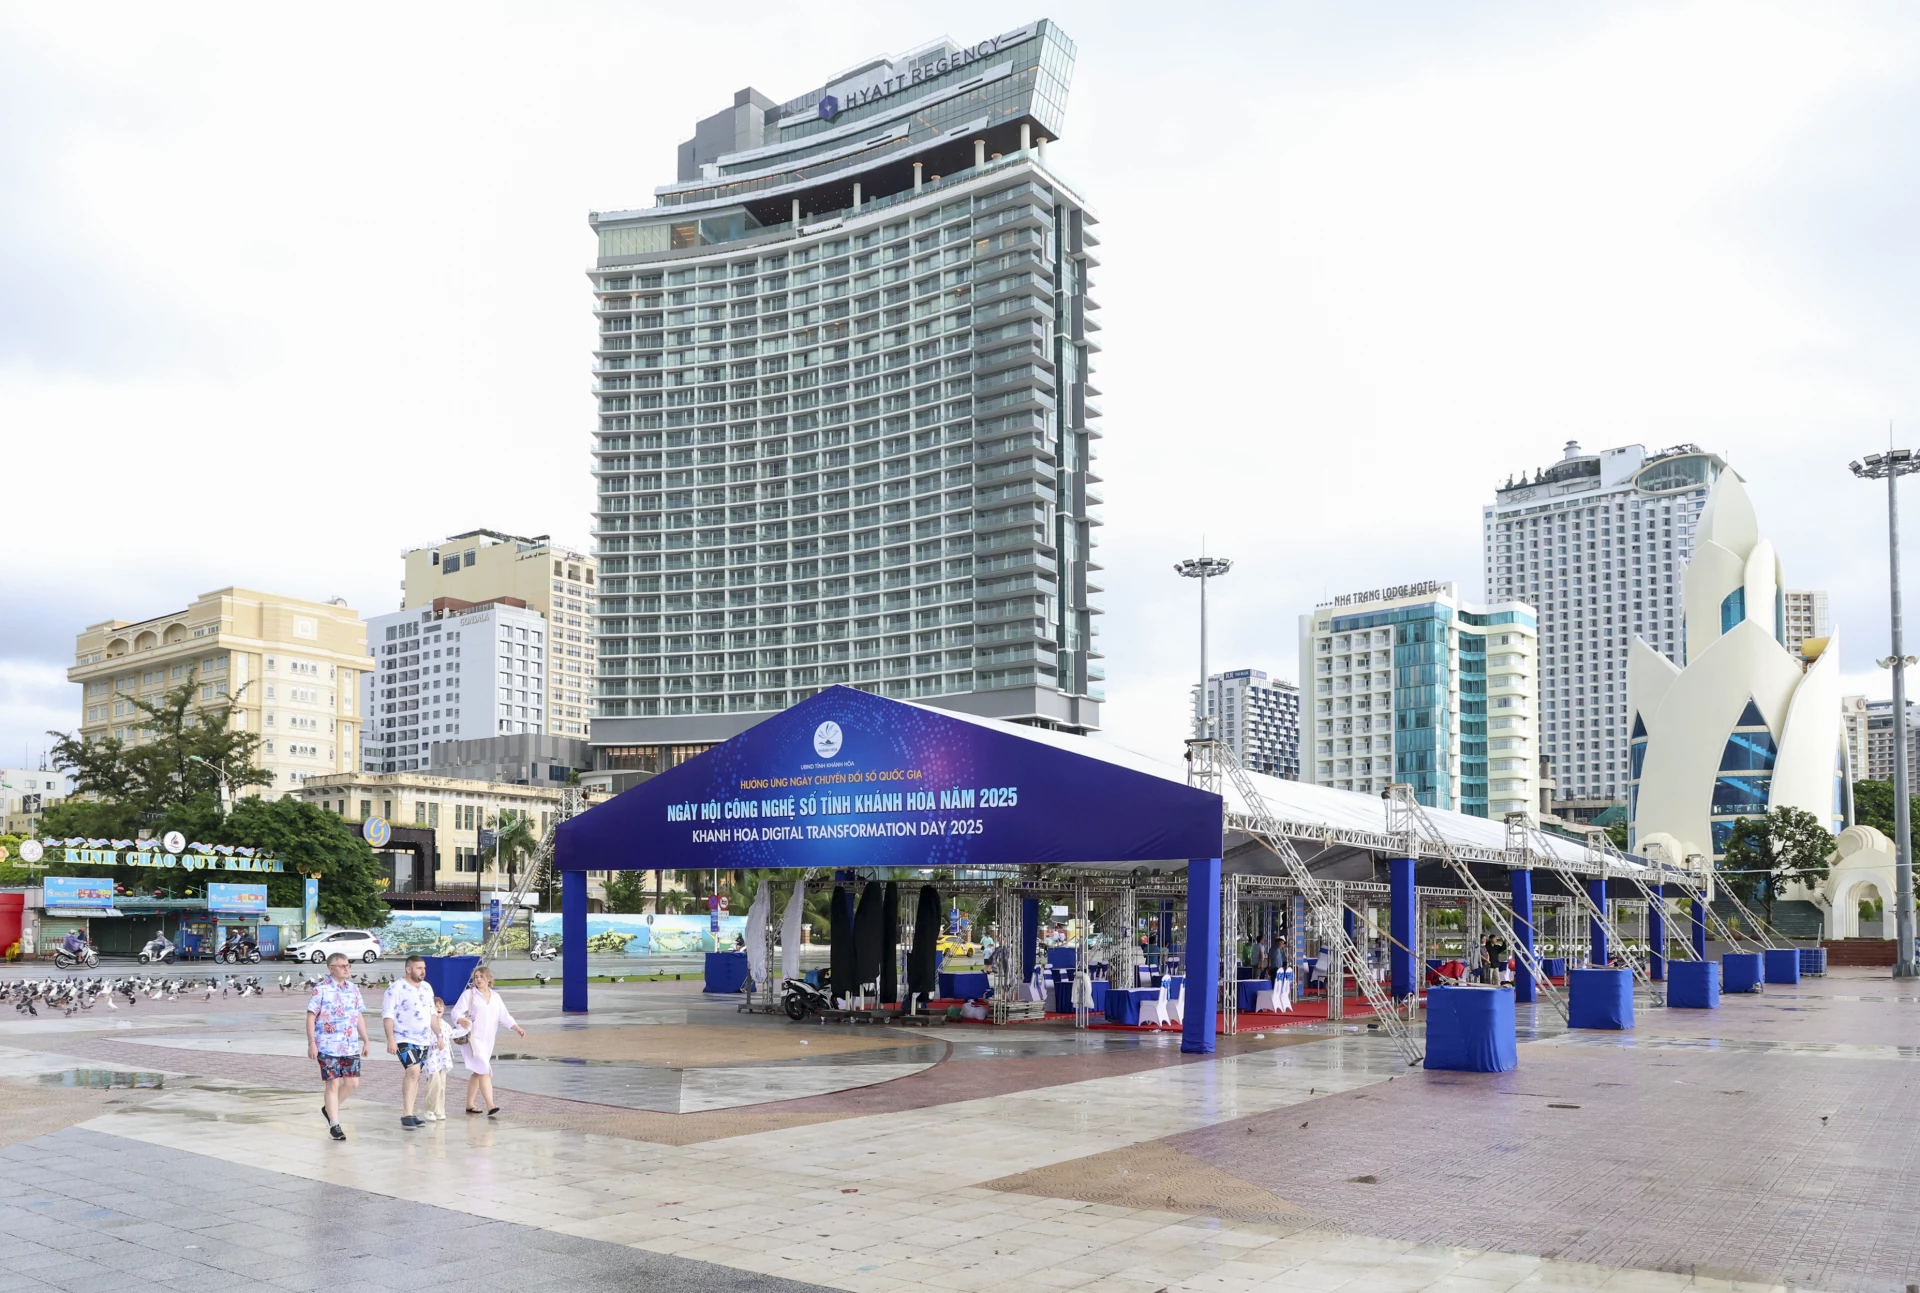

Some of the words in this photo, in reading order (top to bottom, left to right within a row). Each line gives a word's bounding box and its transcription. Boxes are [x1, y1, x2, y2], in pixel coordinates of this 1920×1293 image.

[846, 74, 905, 108] HYATT
[911, 35, 1002, 84] REGENCY
[1334, 594, 1351, 607] NHA
[1353, 588, 1380, 604] TRANG
[1382, 584, 1408, 599] LODGE
[1411, 580, 1437, 596] HOTEL
[770, 775, 788, 788] ỨNG
[790, 773, 813, 787] NGÀY
[814, 769, 846, 785] CHUYỂN
[848, 769, 863, 783] ĐỔI
[865, 768, 877, 782] SỐ
[879, 767, 905, 781] QUỐC
[907, 769, 922, 780] GIA
[800, 763, 814, 771] UBND
[826, 760, 843, 768] KHÁNH
[667, 800, 698, 822] NGÀY
[701, 798, 721, 823] HỘI
[724, 797, 758, 819] CÔNG
[761, 795, 796, 820] NGHỆ
[799, 791, 817, 816] SỐ
[820, 790, 850, 815] TỈNH
[854, 790, 902, 814] KHÁNH
[906, 787, 936, 811] HÒA
[940, 785, 975, 810] NĂM
[979, 787, 1018, 808] 2025
[692, 829, 731, 843] KHANH
[733, 827, 759, 842] HOA
[762, 826, 804, 841] DIGITAL
[806, 821, 916, 840] TRANSFORMATION
[920, 820, 947, 836] DAY
[950, 819, 984, 835] 2025
[64, 842, 117, 865] KÍNH
[126, 846, 177, 868] CHÀO
[224, 852, 284, 873] KHÁCH
